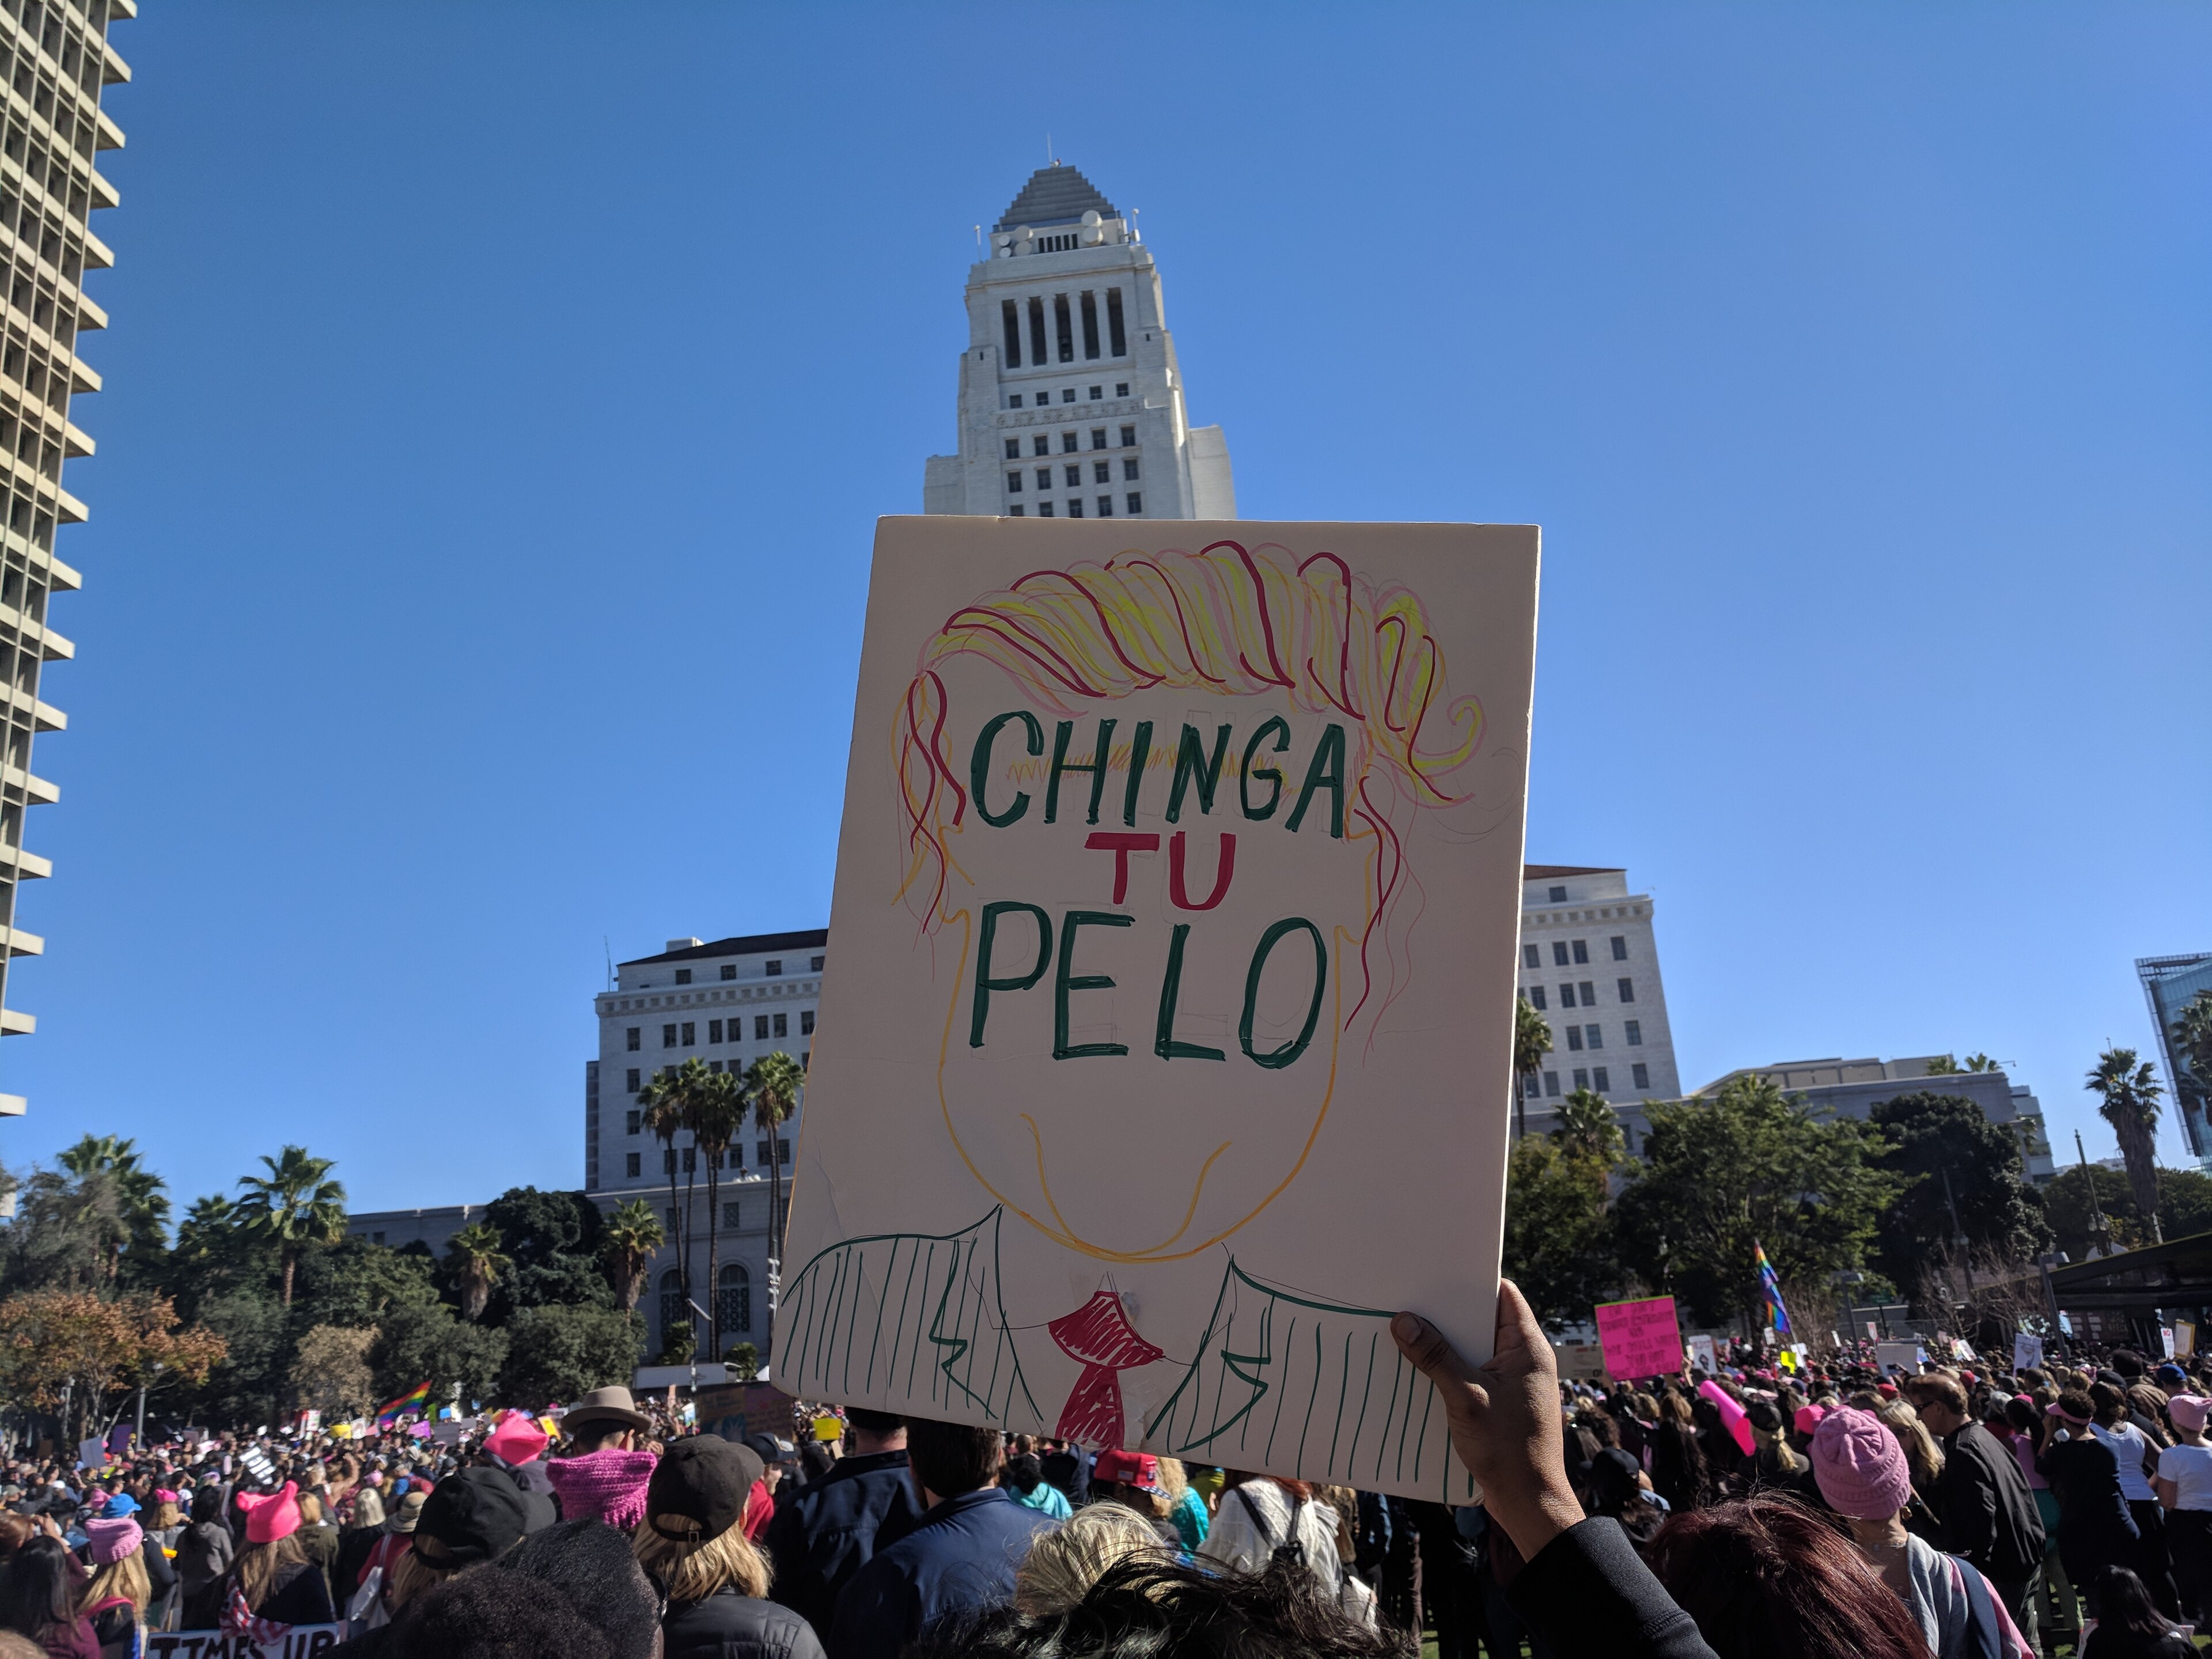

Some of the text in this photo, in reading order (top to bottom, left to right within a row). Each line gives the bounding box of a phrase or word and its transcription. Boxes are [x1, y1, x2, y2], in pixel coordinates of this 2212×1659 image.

[971, 710, 1346, 839] CHINGA
[1084, 831, 1236, 911] TU
[969, 901, 1328, 1070] PELO
